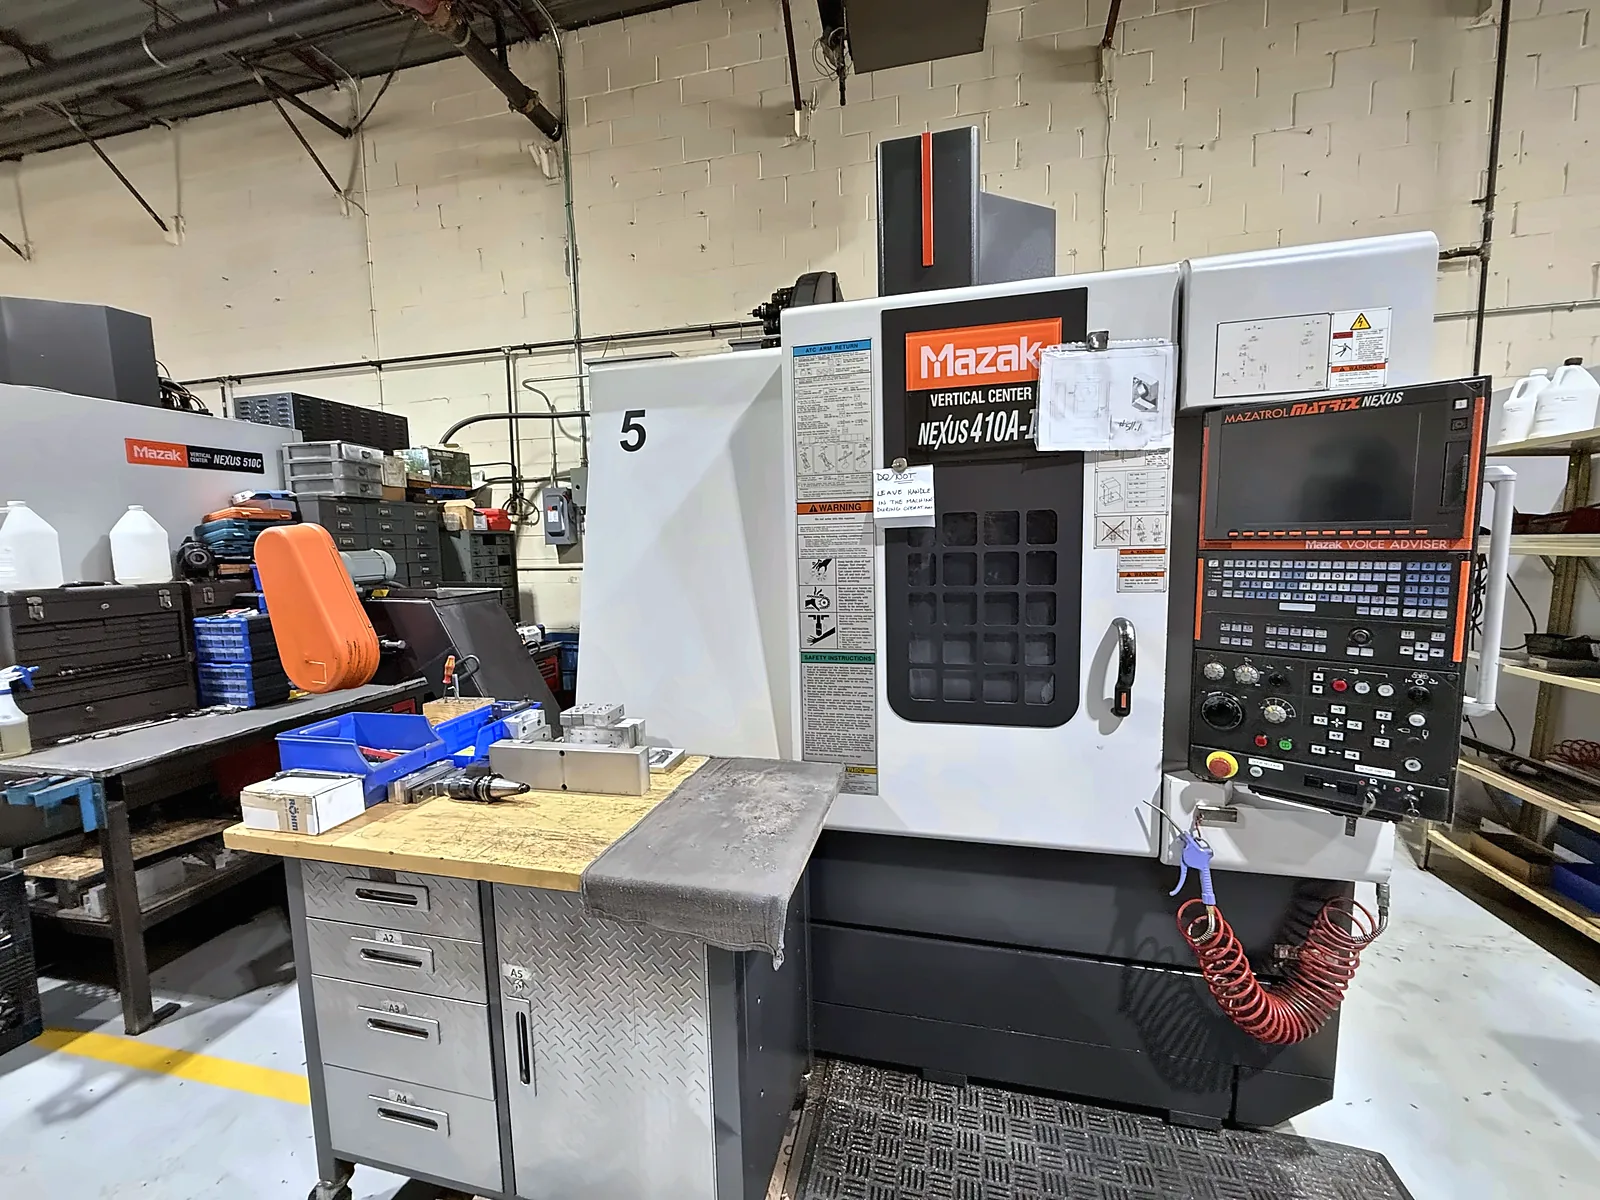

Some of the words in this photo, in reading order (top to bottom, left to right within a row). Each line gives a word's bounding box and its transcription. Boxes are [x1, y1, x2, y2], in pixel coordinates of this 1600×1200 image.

[820, 344, 832, 352] ARM
[835, 342, 859, 350] RETURN
[920, 336, 1042, 379] Mazak
[930, 390, 985, 407] VERTICAL
[988, 387, 1032, 403] CENTER
[1224, 408, 1289, 424] MAZATROL
[1362, 391, 1404, 408] NEXUS
[619, 409, 647, 452] 5
[918, 414, 969, 450] NEXUS
[133, 445, 182, 462] Mazak
[190, 451, 212, 459] VERTICAL
[213, 454, 241, 467] NEXUS
[243, 457, 262, 468] 510C
[877, 489, 902, 497] LEAVE
[819, 502, 862, 512] WARNING
[1305, 539, 1342, 550] Mazak
[1346, 539, 1385, 550] VOICE
[1390, 539, 1447, 550] ADVISER
[383, 934, 395, 943] A2
[510, 969, 523, 978] A5
[389, 1003, 400, 1013] A3
[396, 1094, 408, 1103] A4
